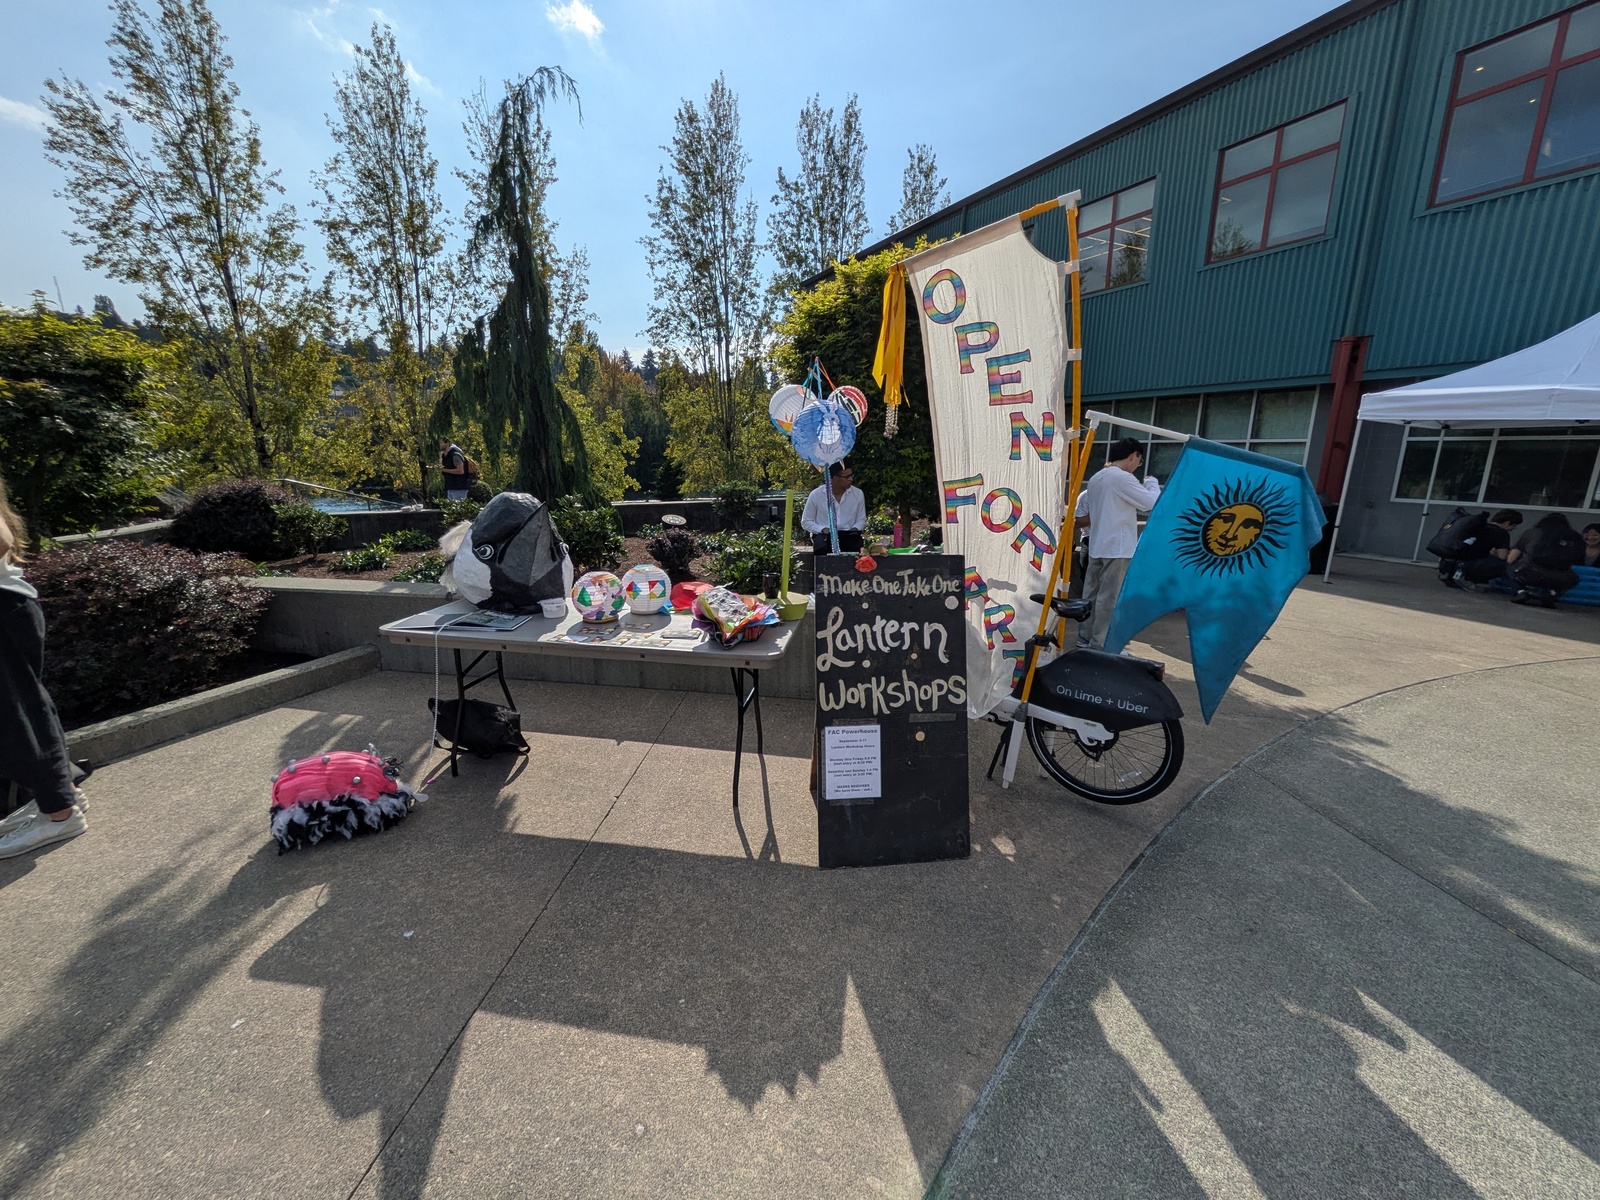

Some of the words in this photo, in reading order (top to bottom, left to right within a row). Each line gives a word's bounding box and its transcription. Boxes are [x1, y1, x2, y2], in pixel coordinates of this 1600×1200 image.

[923, 268, 1054, 461] OPEN
[943, 474, 1056, 571] FOR
[872, 575, 900, 596] One
[896, 568, 932, 598] Take
[932, 574, 961, 594] One
[816, 606, 950, 672] Lantern
[965, 566, 1026, 688] ART
[819, 669, 966, 715] Workshops
[1056, 685, 1072, 696] On
[1074, 690, 1102, 704] Lime
[1118, 700, 1148, 714] Uber
